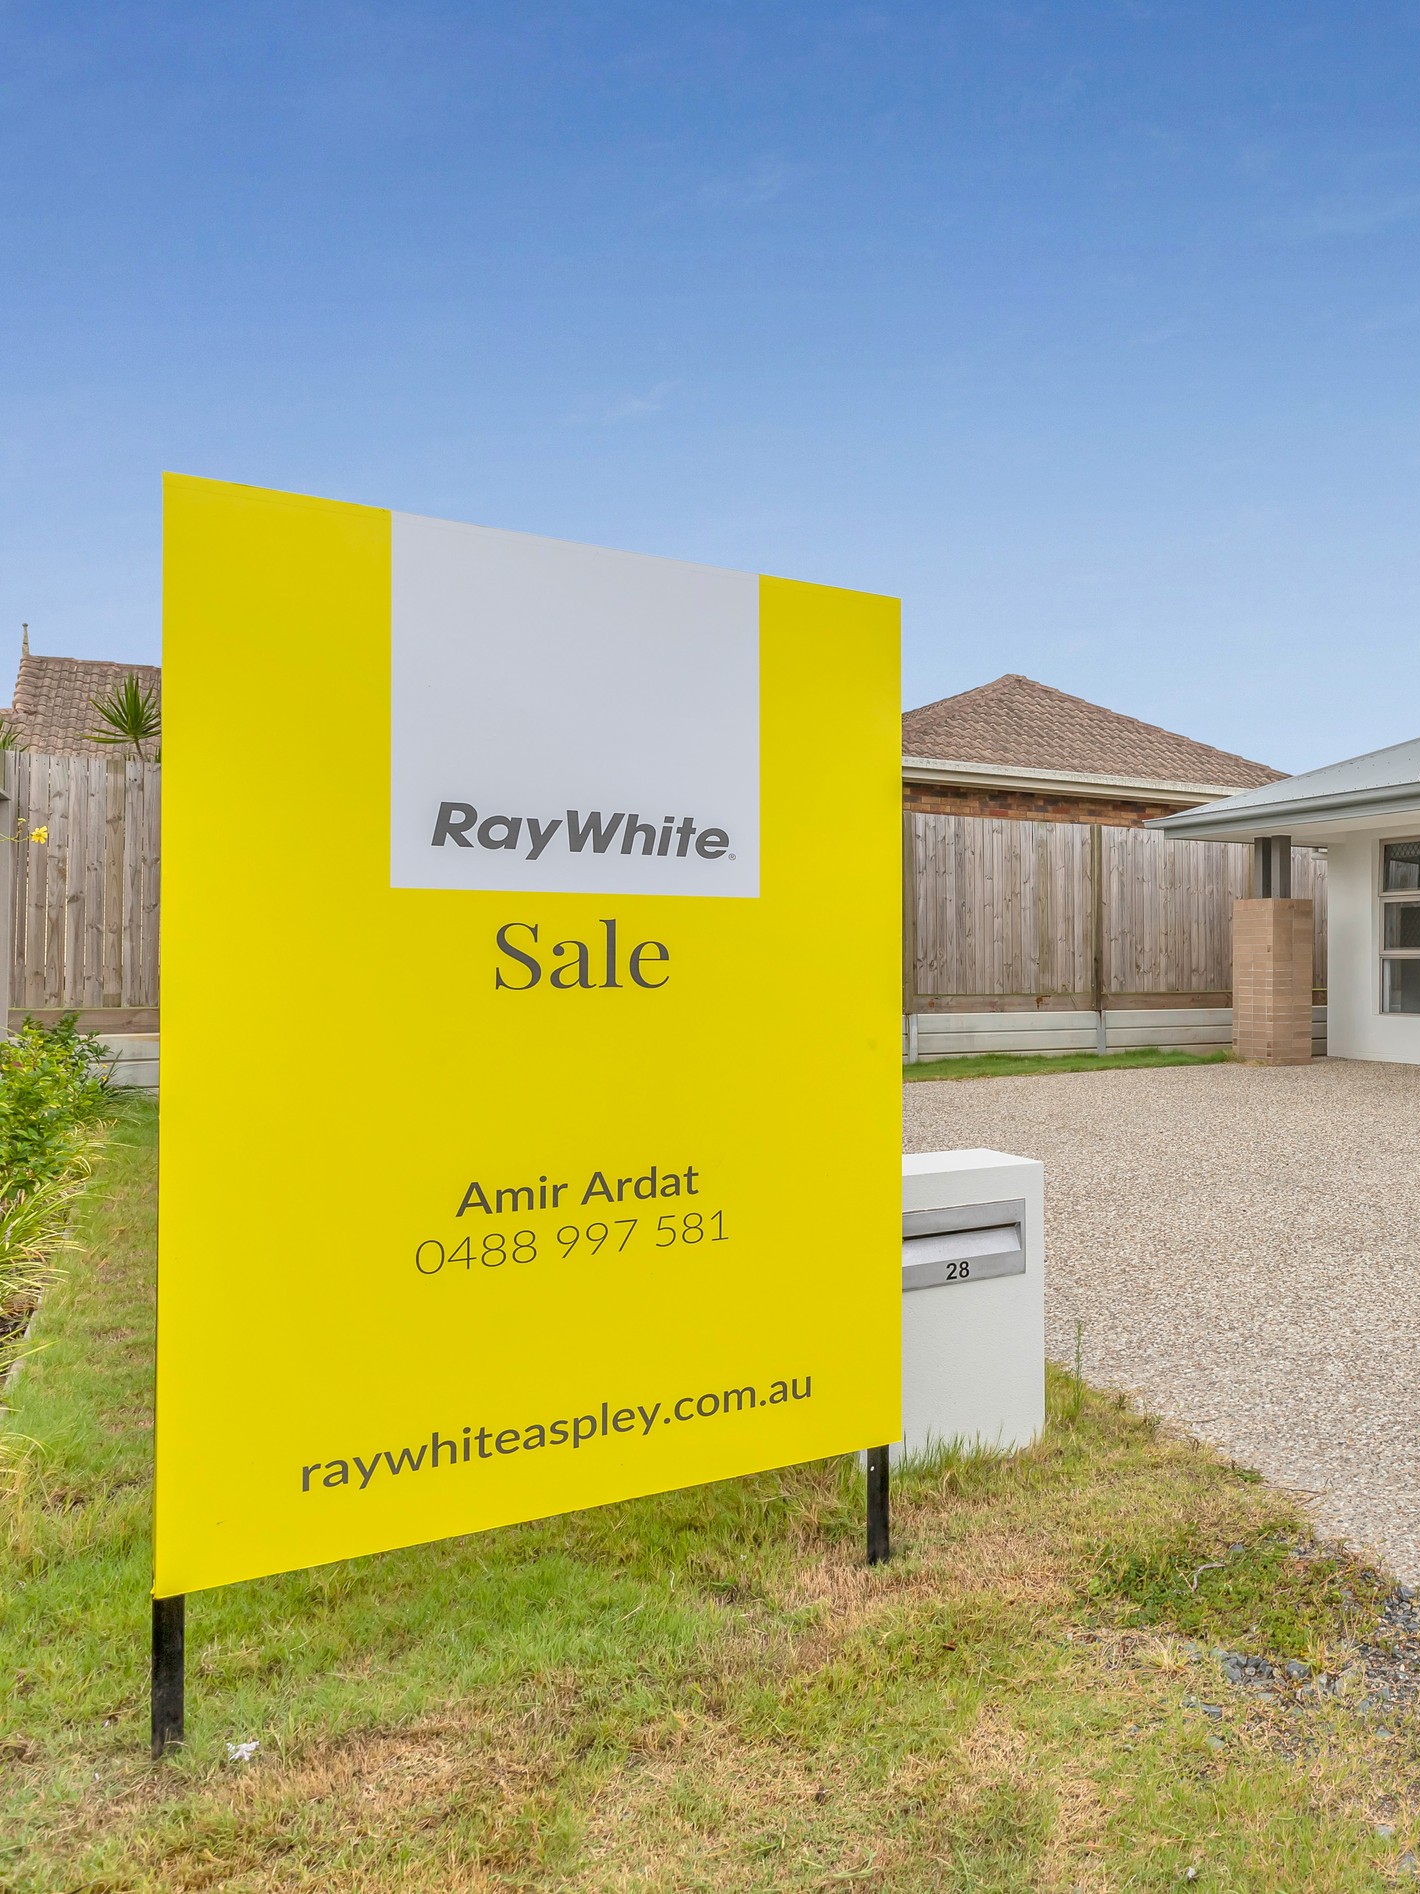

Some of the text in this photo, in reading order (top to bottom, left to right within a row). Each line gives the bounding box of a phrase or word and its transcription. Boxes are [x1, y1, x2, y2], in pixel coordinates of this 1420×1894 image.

[495, 919, 670, 990] Sale
[456, 1166, 700, 1217] Amir Ardat
[415, 1210, 729, 1274] 0488 997 581
[946, 1261, 970, 1280] 28
[302, 1376, 813, 1492] raywhiteaspley.com.au
